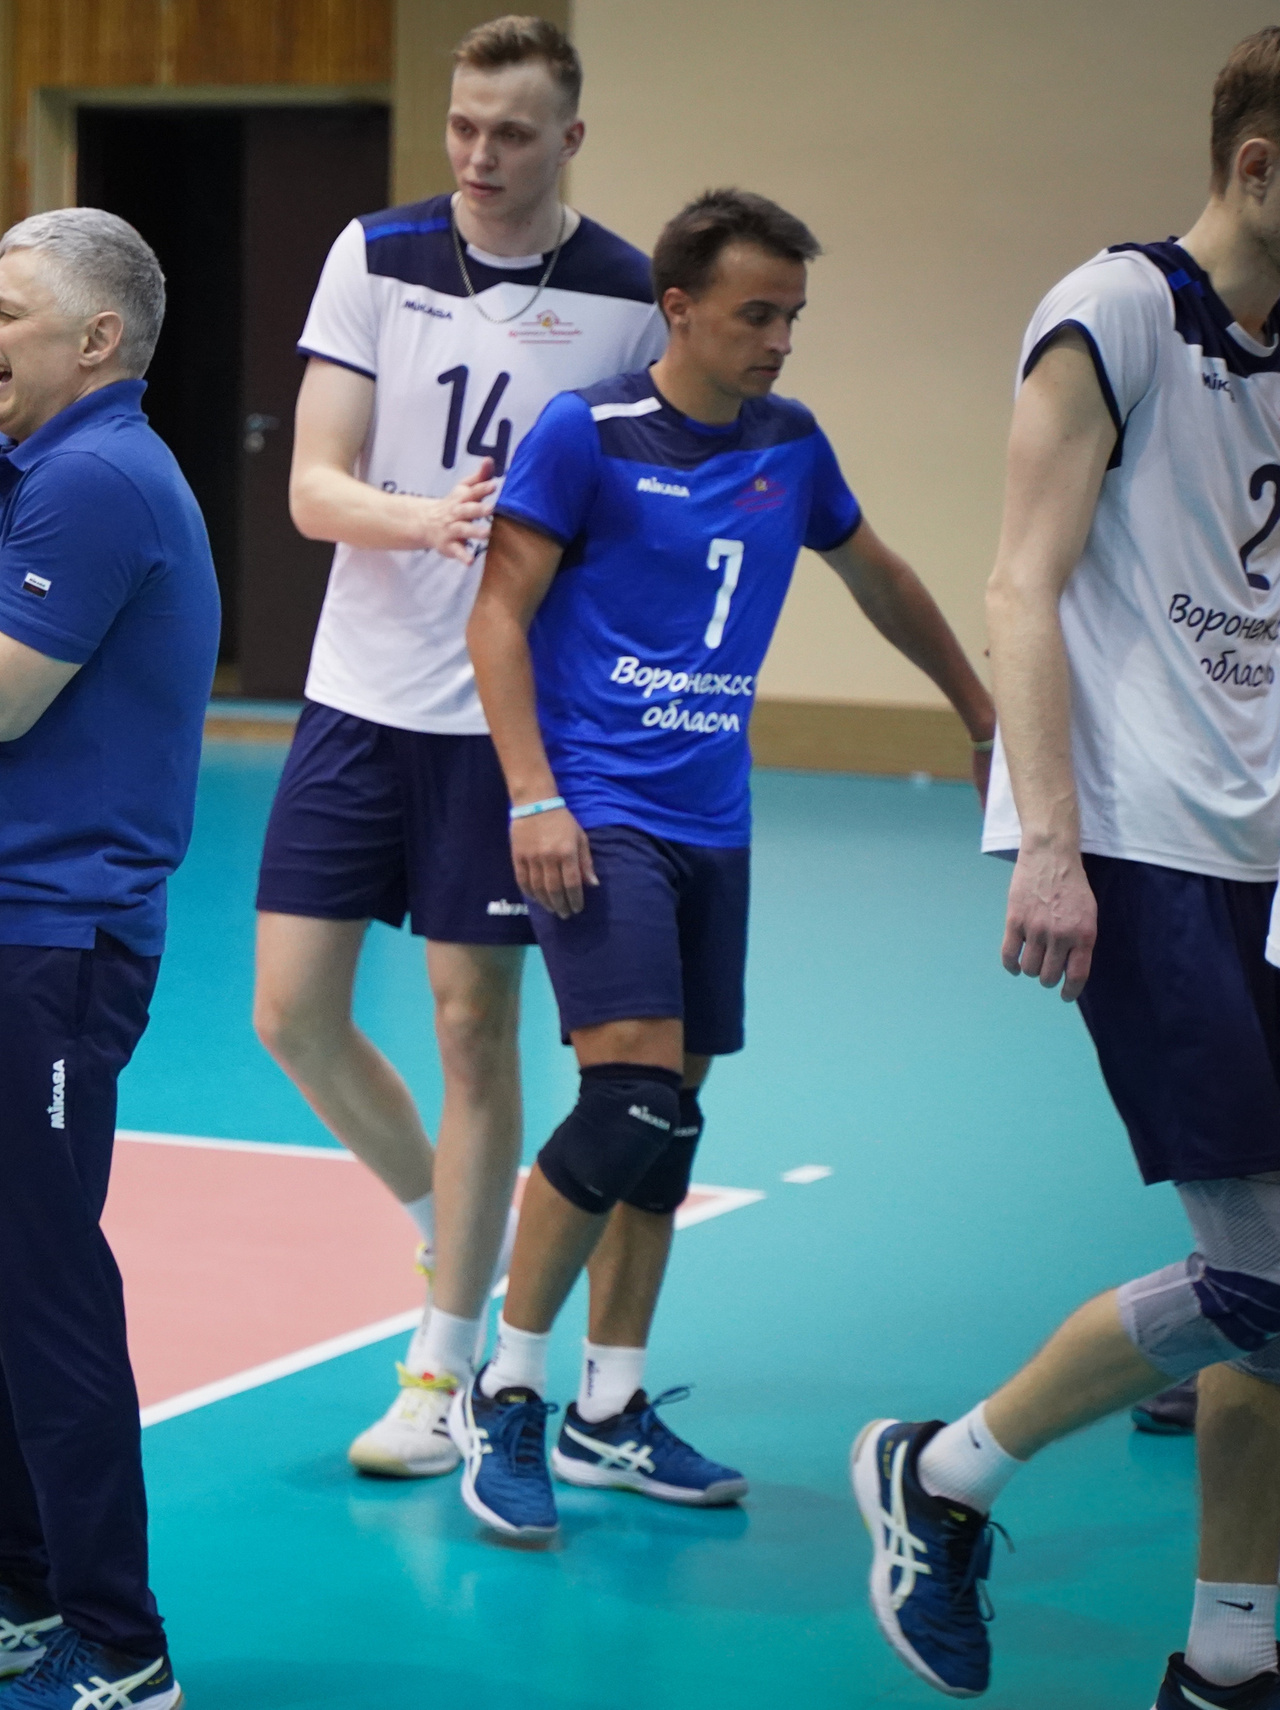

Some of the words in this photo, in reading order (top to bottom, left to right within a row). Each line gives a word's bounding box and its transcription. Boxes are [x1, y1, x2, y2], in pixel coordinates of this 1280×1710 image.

[437, 365, 512, 478] 14
[1238, 463, 1280, 591] 2
[704, 537, 744, 649] 7
